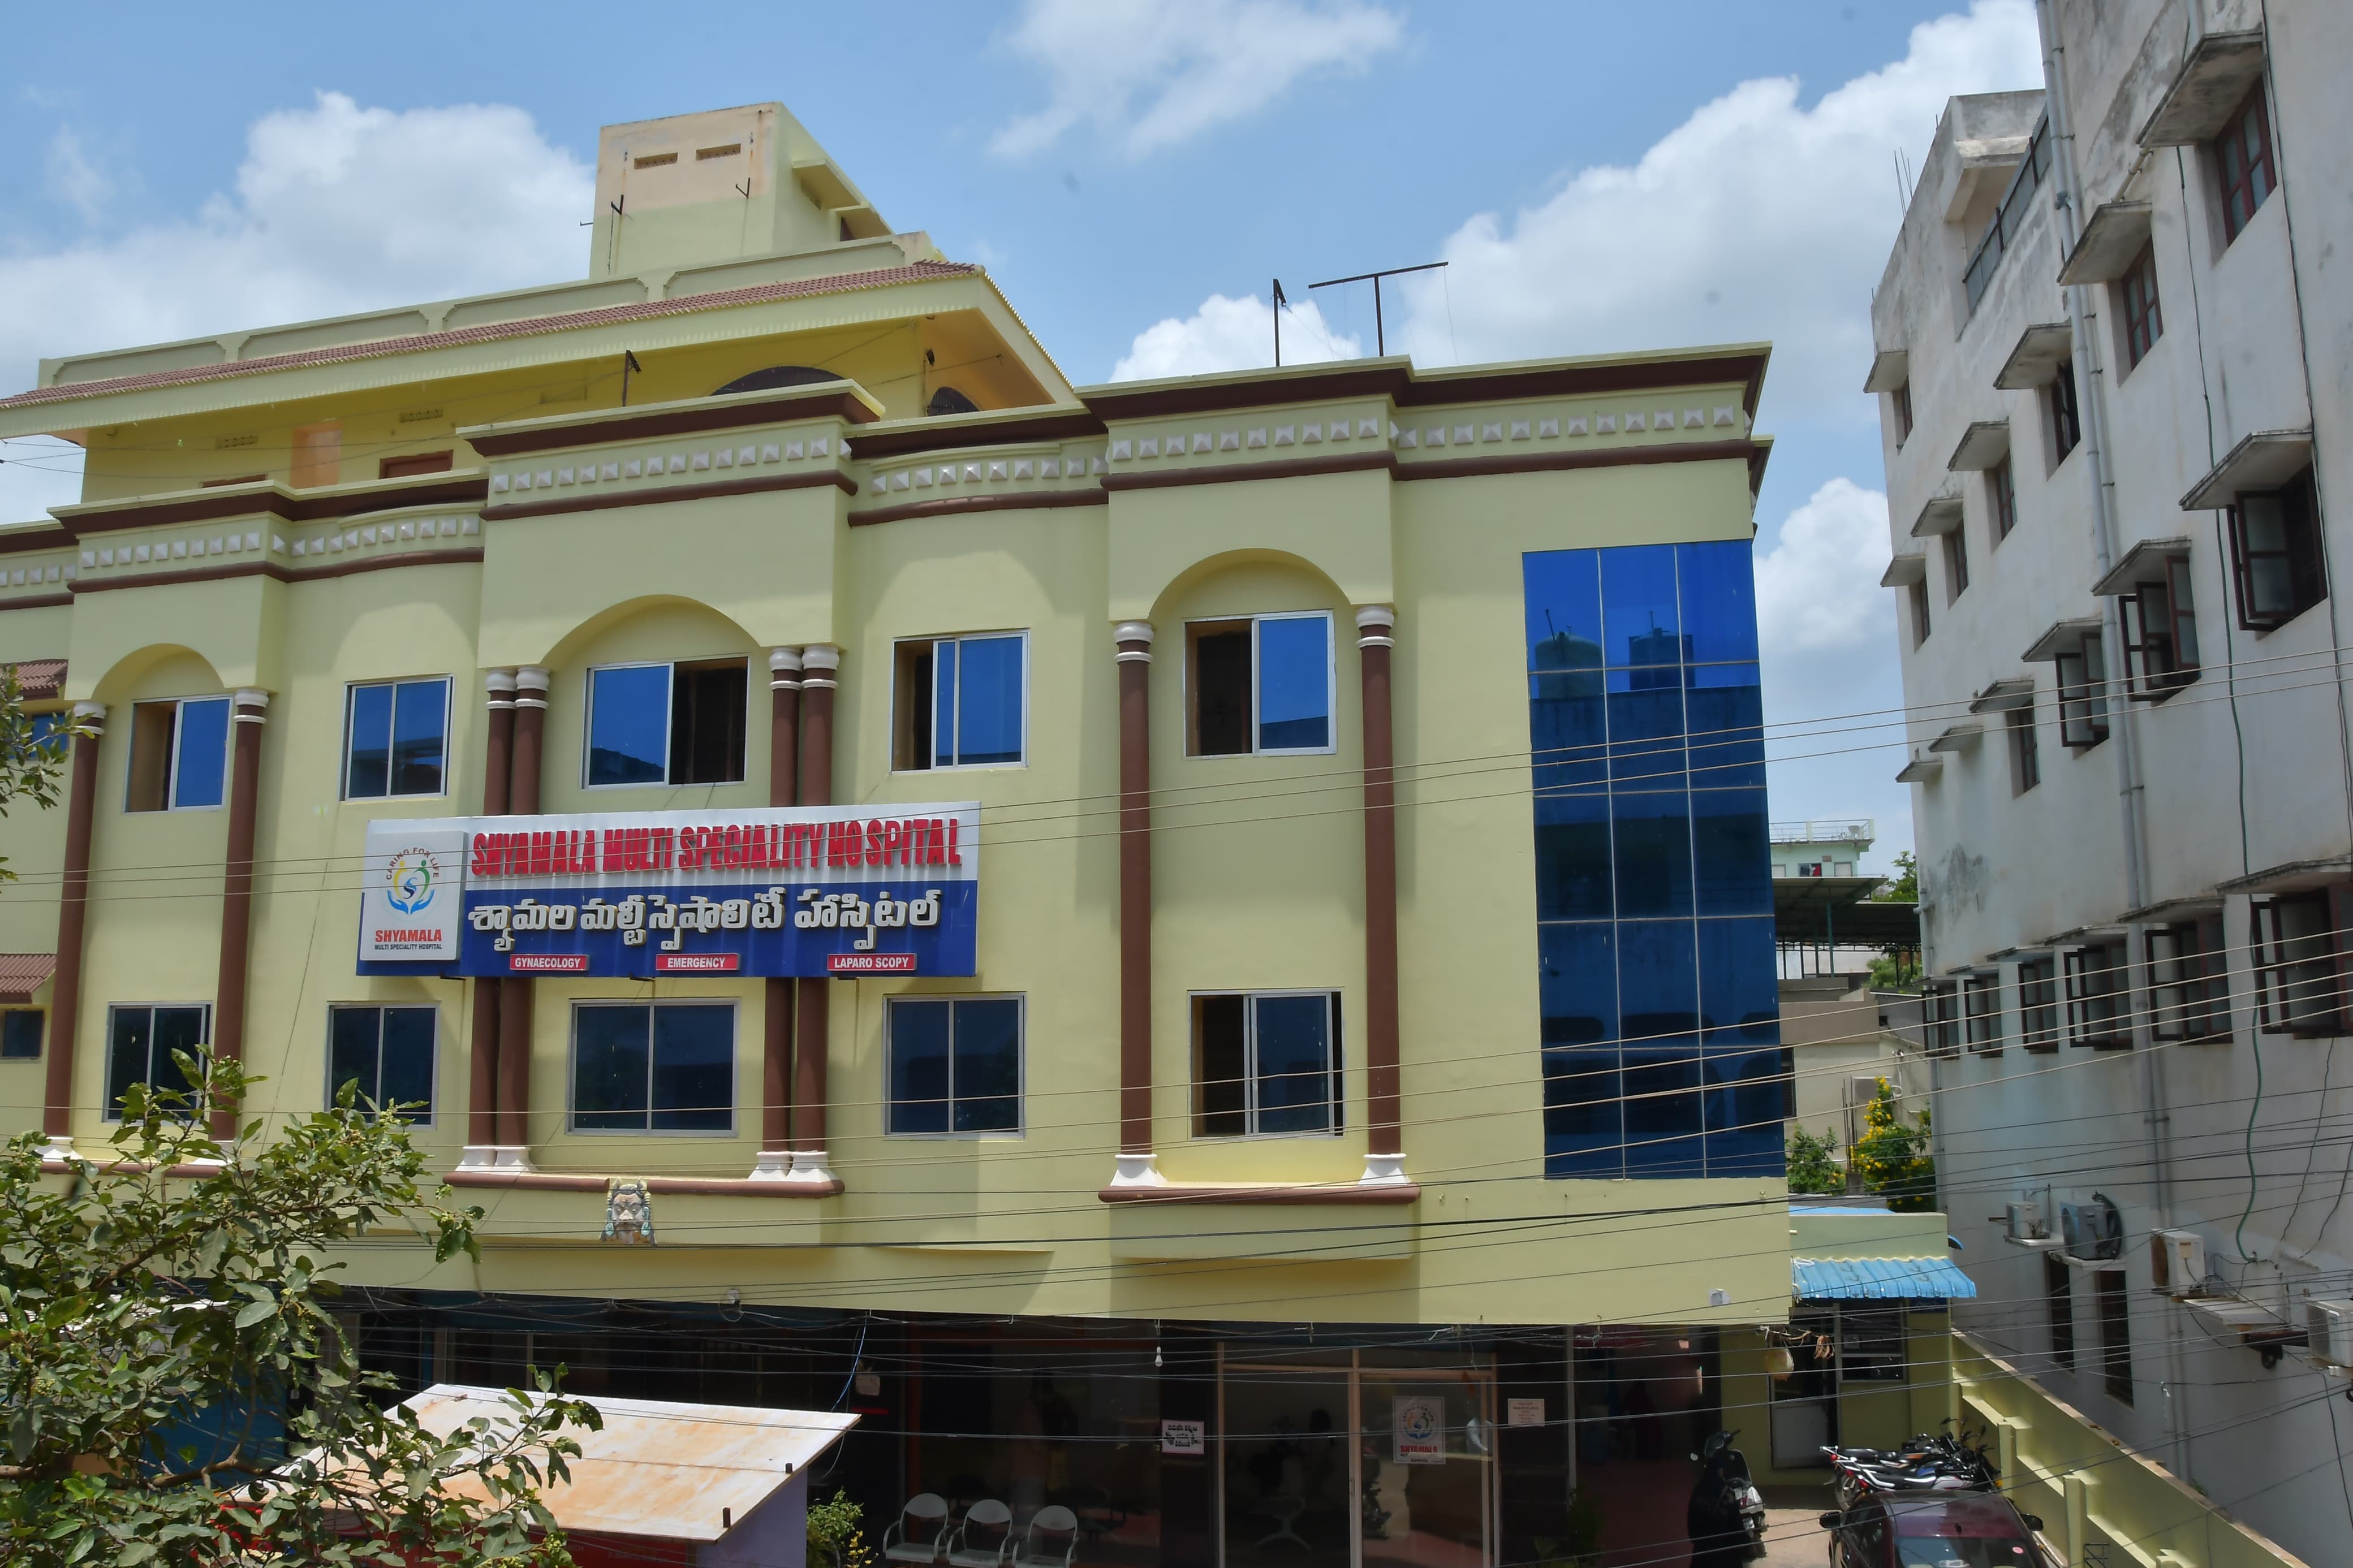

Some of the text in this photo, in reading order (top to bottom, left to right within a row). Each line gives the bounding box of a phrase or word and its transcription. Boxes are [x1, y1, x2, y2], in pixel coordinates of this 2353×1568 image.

[472, 818, 961, 875] SHYAMALA MULTI SPECIALITY HOSPITAL
[386, 847, 439, 880] CARING FOR LIFE
[375, 929, 442, 943] SHYAMALA
[515, 957, 581, 968] GYNAECOLOGY
[667, 957, 726, 968] EMERGENCY
[834, 957, 909, 968] LAPARO SCOPY
